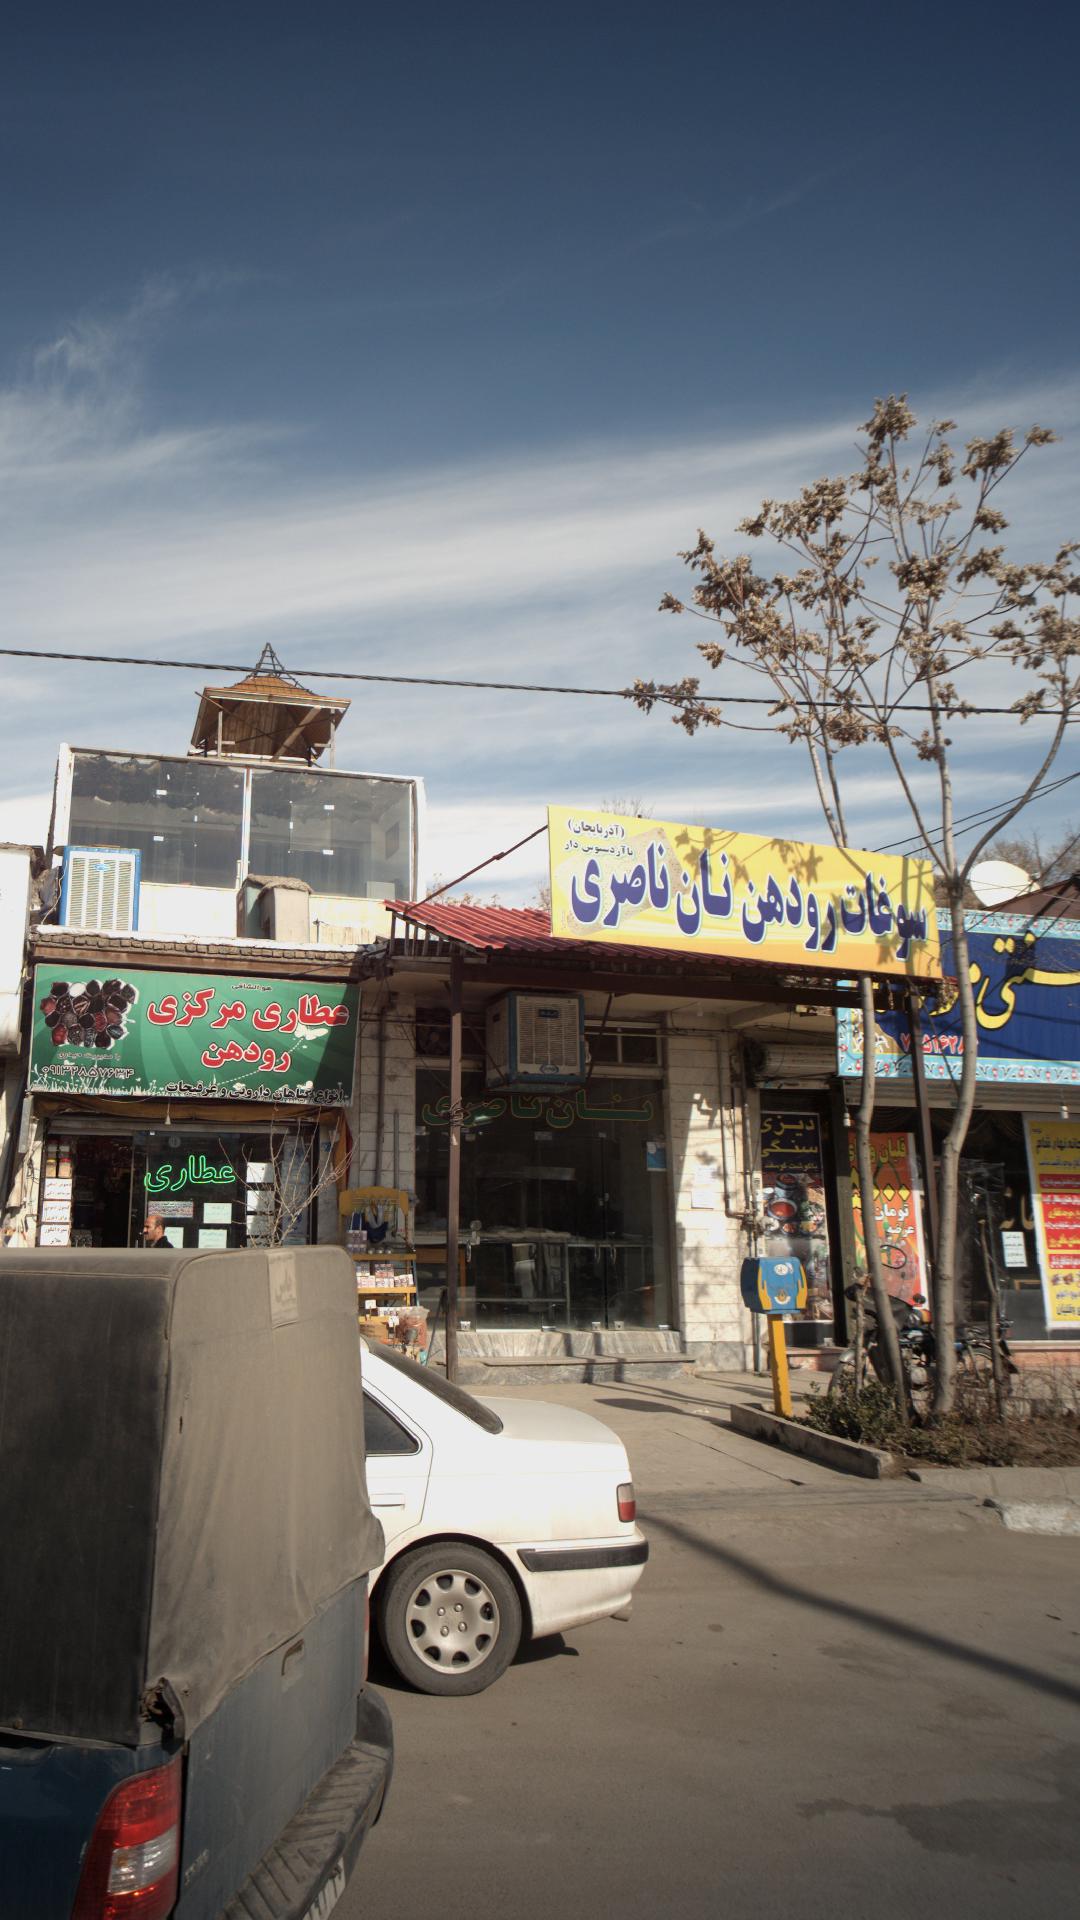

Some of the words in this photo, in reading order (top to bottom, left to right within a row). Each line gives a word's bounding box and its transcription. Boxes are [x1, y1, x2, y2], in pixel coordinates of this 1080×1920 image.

[571, 841, 670, 927] ناصری
[676, 848, 733, 936] نان
[742, 873, 838, 952] رودهن
[840, 872, 928, 960] سوغات
[147, 988, 247, 1028] مرکزی
[252, 993, 350, 1033] عطاری
[201, 1040, 291, 1072] رودهن
[144, 1155, 236, 1192] عطاری
